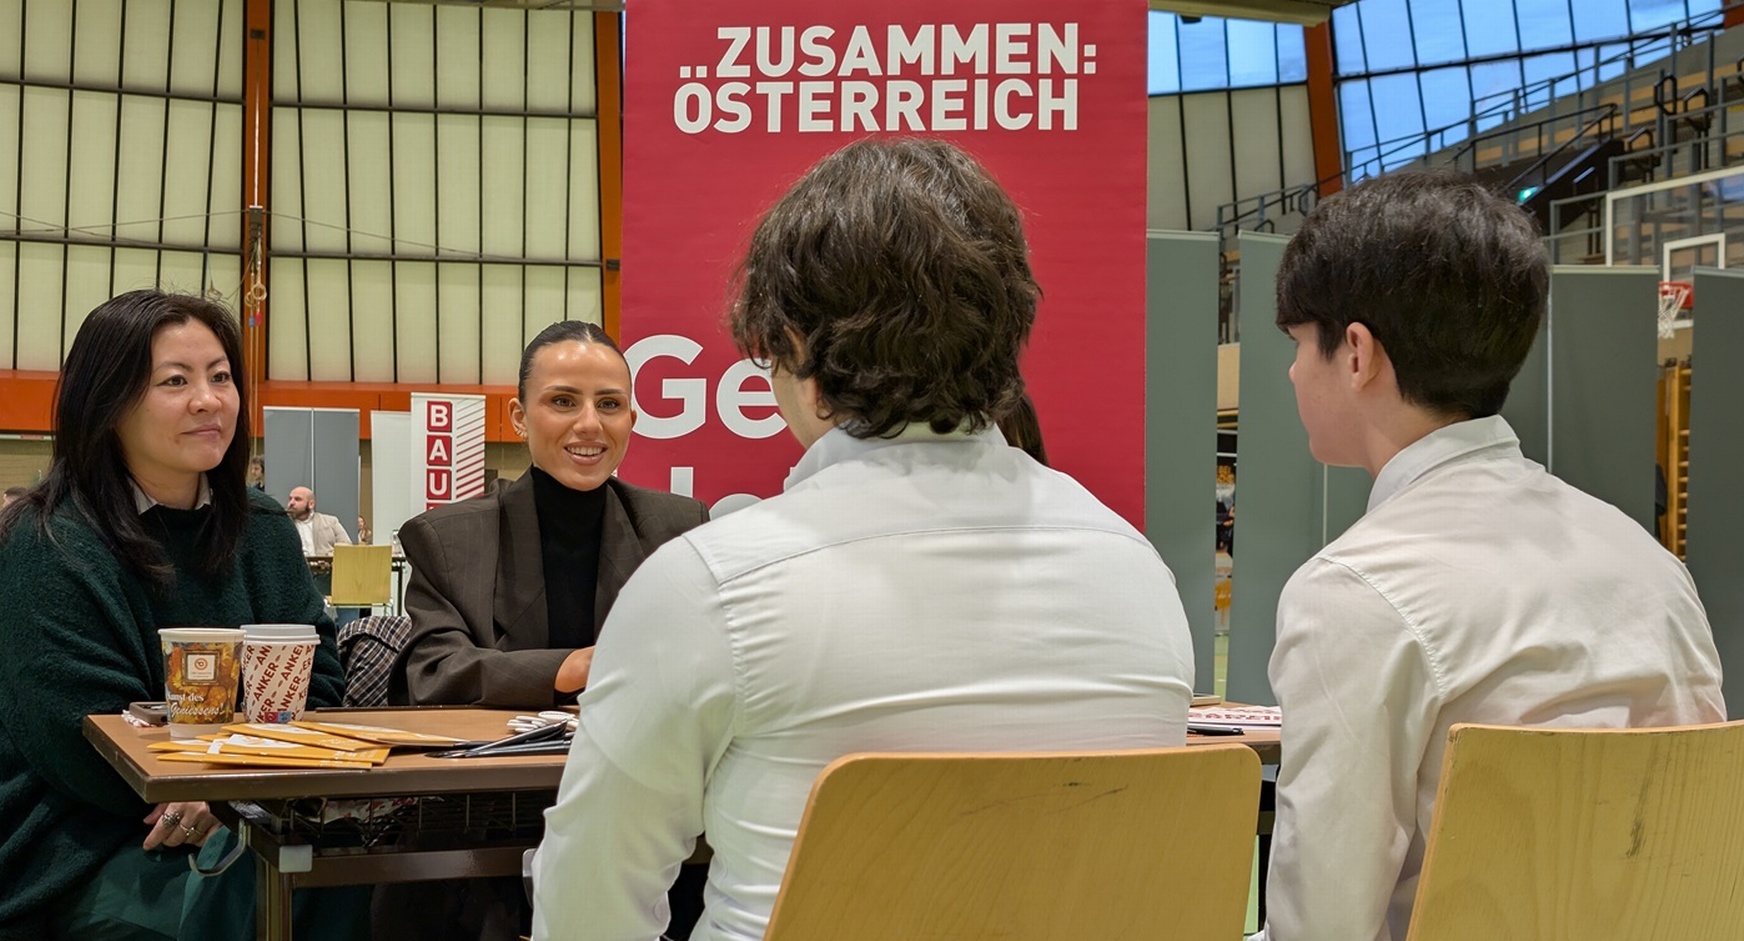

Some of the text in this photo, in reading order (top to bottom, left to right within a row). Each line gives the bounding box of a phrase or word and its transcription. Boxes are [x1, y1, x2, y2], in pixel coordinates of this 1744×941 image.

[716, 23, 1096, 78] ZUSAMMEN:
[673, 65, 1078, 134] ÖSTERREICH
[429, 404, 448, 509] BAU
[254, 662, 278, 701] ANKER
